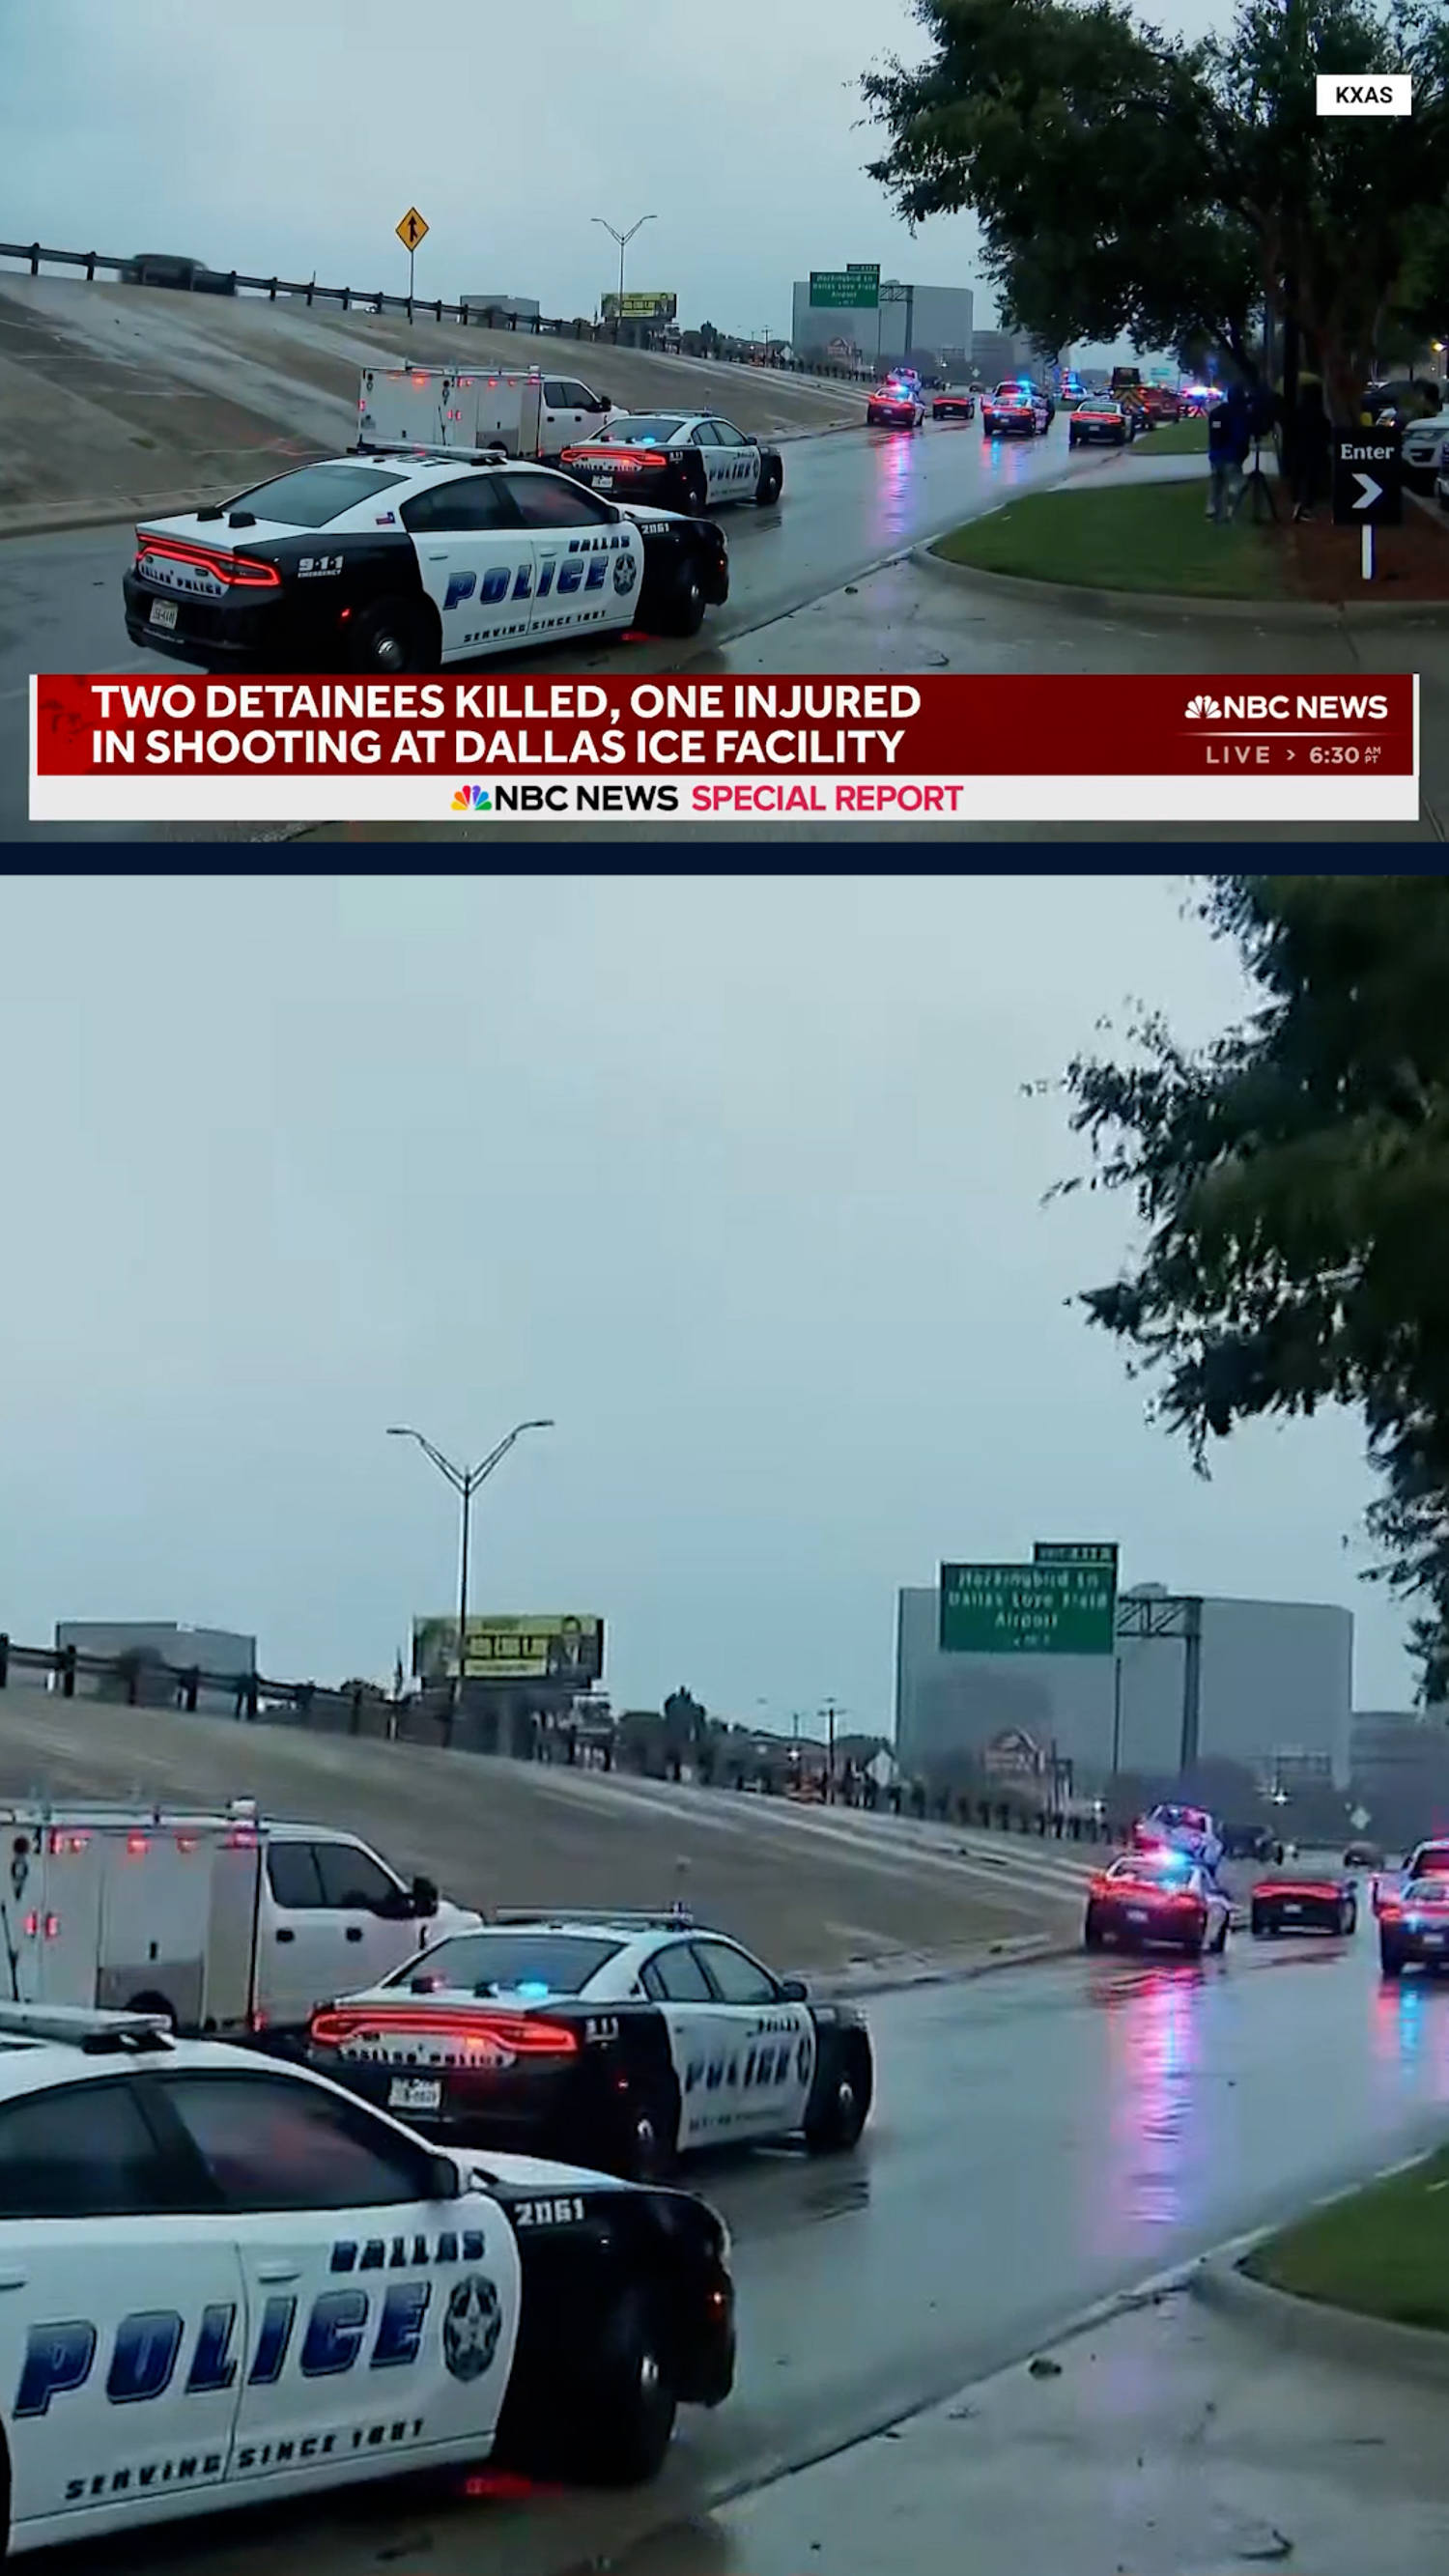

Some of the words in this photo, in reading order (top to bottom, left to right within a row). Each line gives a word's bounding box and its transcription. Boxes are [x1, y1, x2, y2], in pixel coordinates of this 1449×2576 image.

[1340, 442, 1395, 461] Enter
[568, 535, 631, 553] DALLAS
[641, 523, 670, 535] 2061
[442, 555, 610, 611] POLICE
[463, 623, 526, 643] SERVING
[532, 616, 571, 631] SINCE
[994, 1611, 1059, 1628] Airport
[685, 2046, 792, 2094] POLICE
[513, 2197, 585, 2227] 2061
[330, 2229, 485, 2274] DALLAS
[12, 2280, 432, 2420] POLICE
[65, 2453, 224, 2501] SERVING
[238, 2434, 337, 2470] SINCE
